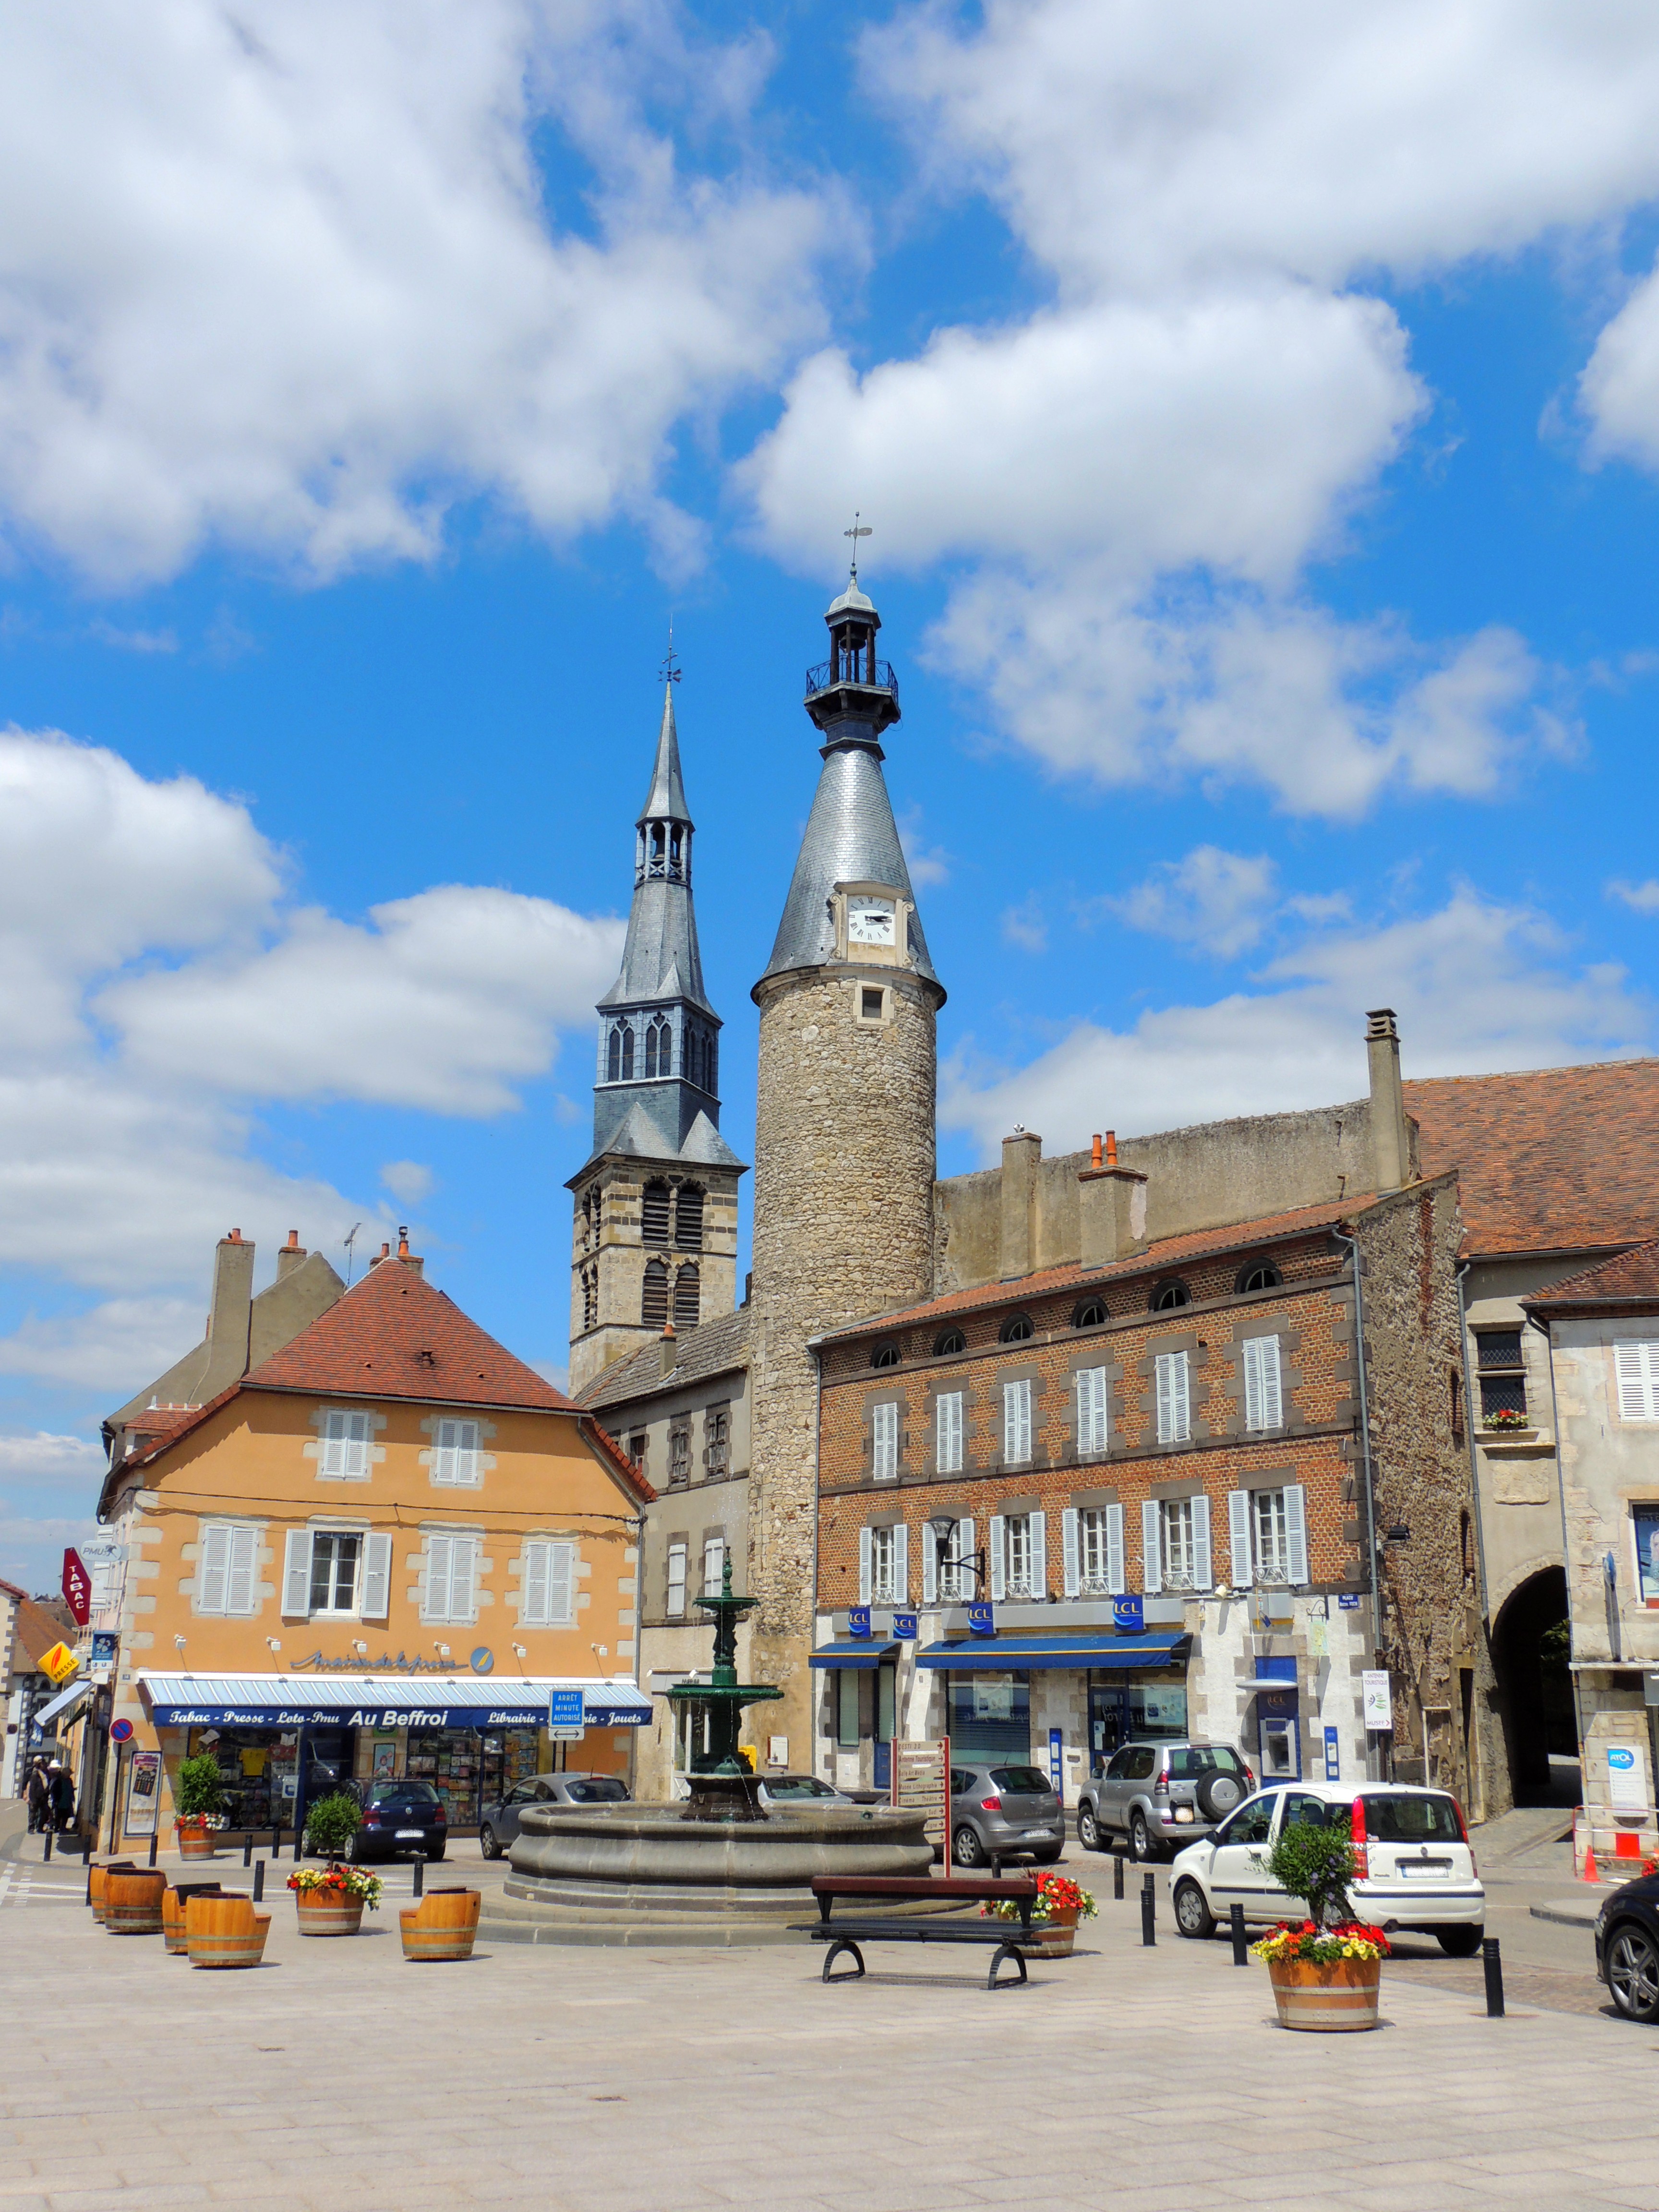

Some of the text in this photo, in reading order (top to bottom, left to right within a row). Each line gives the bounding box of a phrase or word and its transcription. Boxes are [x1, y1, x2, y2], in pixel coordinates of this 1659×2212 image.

[83, 1547, 103, 1556] PMU
[69, 1565, 84, 1609] TABAC
[1114, 1602, 1139, 1613] LCL
[849, 1613, 868, 1623] LCL
[969, 1609, 990, 1619] LCL
[895, 1619, 914, 1627] LCL
[53, 1659, 76, 1680] PRESSE
[558, 1693, 577, 1702] ARRÊT
[169, 1711, 211, 1723] Tabac
[223, 1711, 264, 1723] Presse
[347, 1710, 449, 1726] Au Beffroi
[487, 1712, 536, 1723] Librairie
[607, 1713, 642, 1726] Jouets
[553, 1713, 581, 1722] AUTORISÉ
[915, 1755, 936, 1763] Touristique
[1610, 1753, 1632, 1762] ATOL
